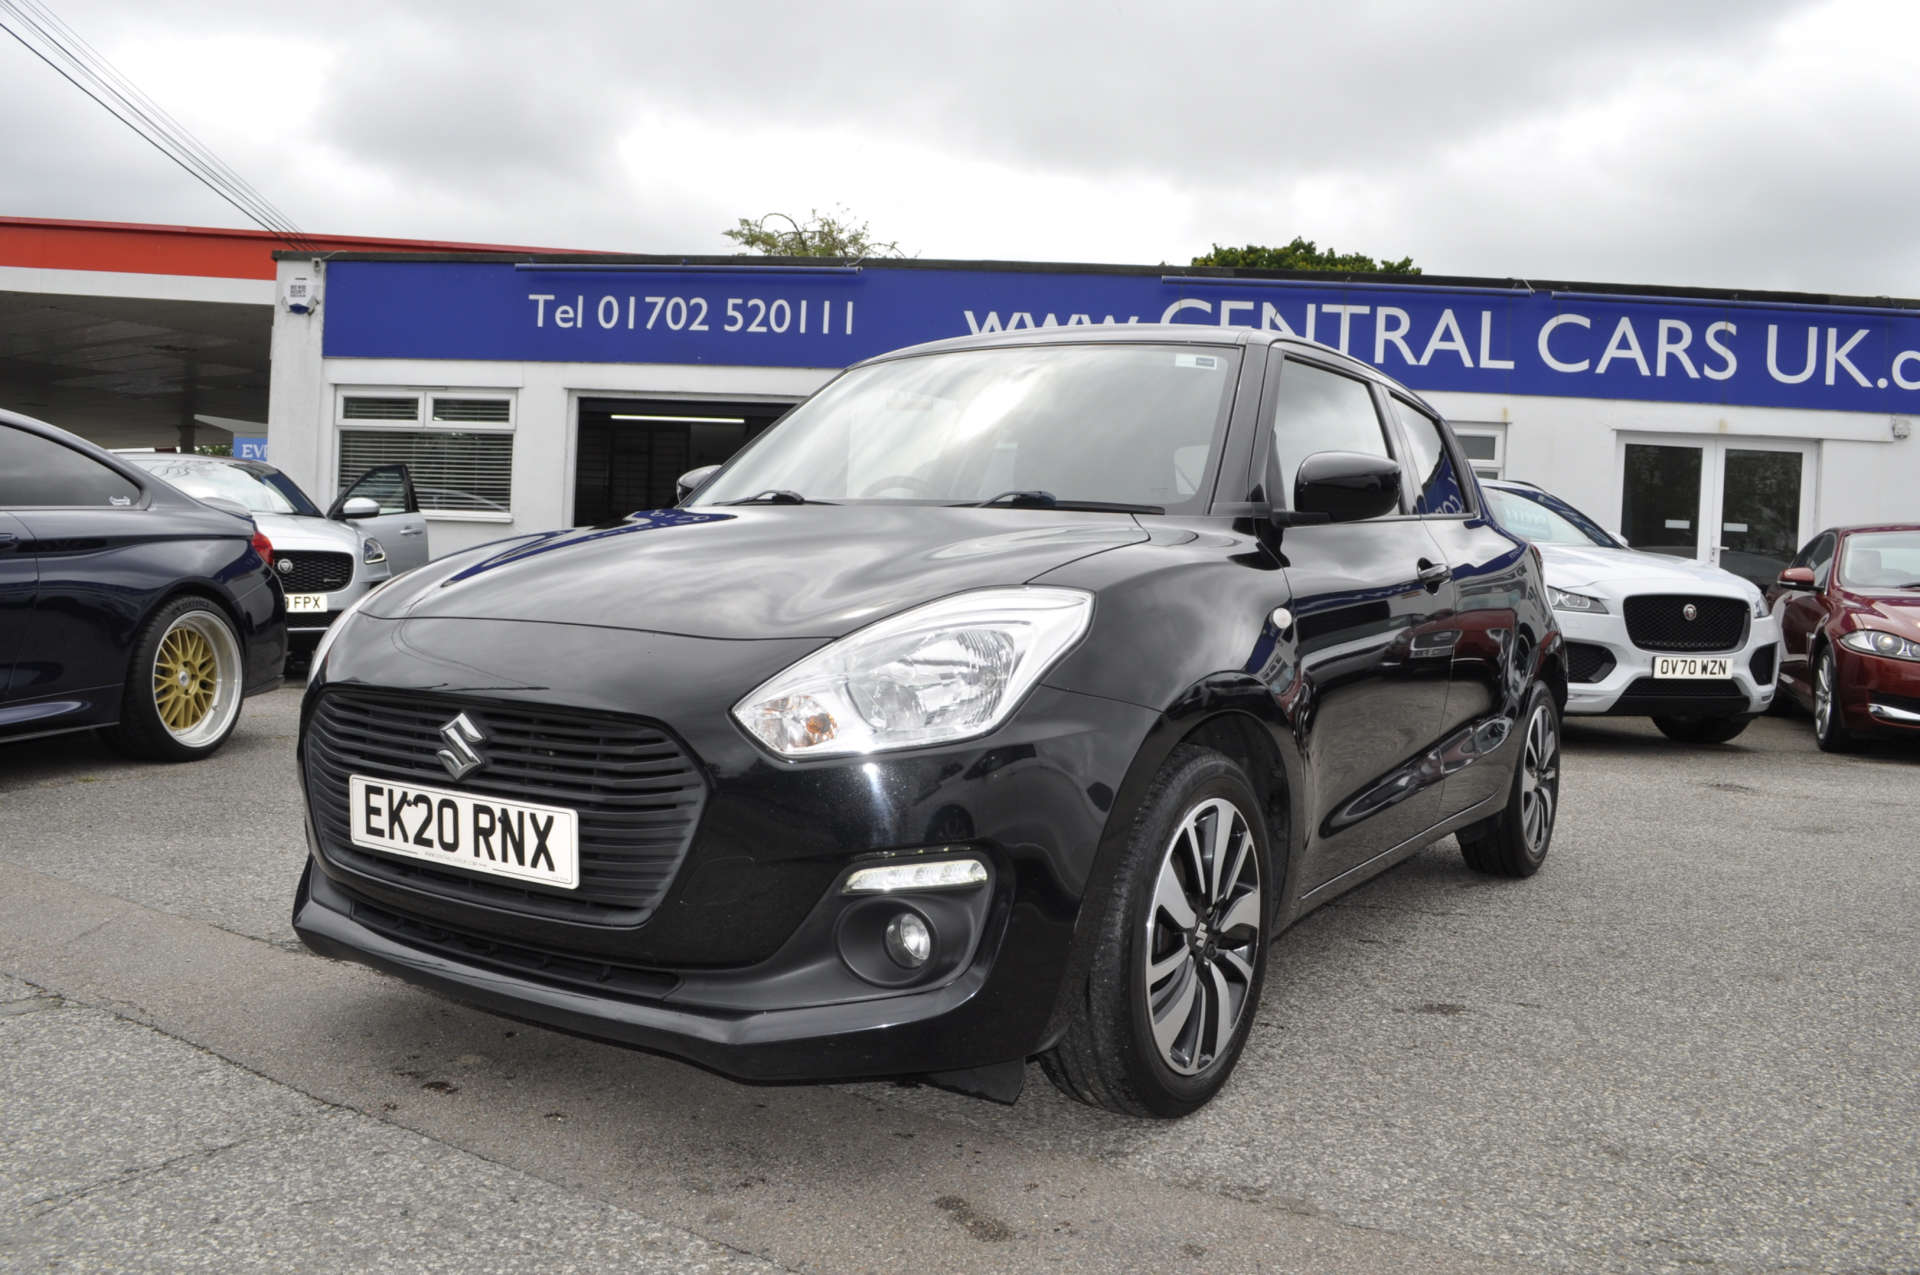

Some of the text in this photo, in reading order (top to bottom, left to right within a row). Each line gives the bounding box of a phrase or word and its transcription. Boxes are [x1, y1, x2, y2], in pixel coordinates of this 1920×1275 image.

[528, 294, 854, 335] Tel 01702 520111
[1537, 313, 1738, 381] CARS
[294, 596, 320, 608] FPX
[1660, 659, 1727, 675] OV70 WZN
[364, 784, 556, 872] EK20 RNX
